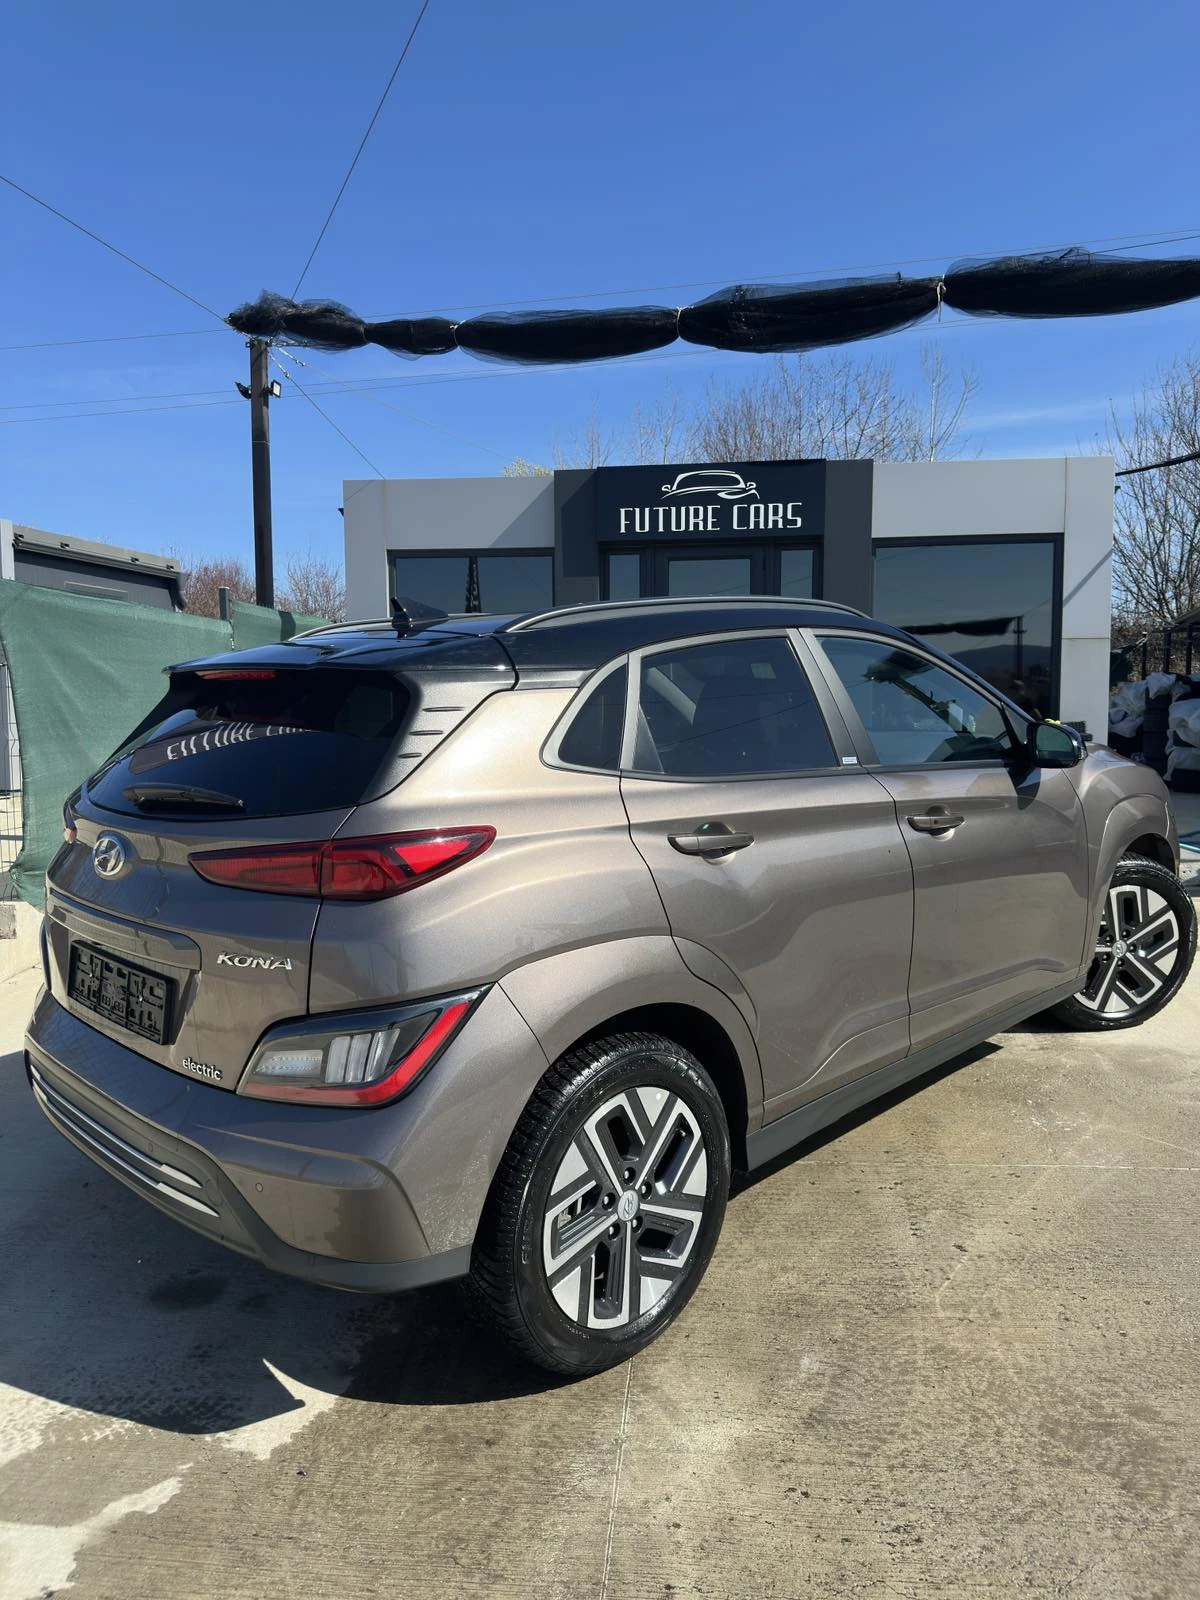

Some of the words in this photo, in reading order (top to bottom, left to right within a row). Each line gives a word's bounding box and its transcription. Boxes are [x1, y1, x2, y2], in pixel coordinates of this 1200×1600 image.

[619, 505, 721, 533] FUTURE
[732, 502, 803, 530] CARS
[216, 952, 293, 970] KONA
[182, 1056, 222, 1081] electric
